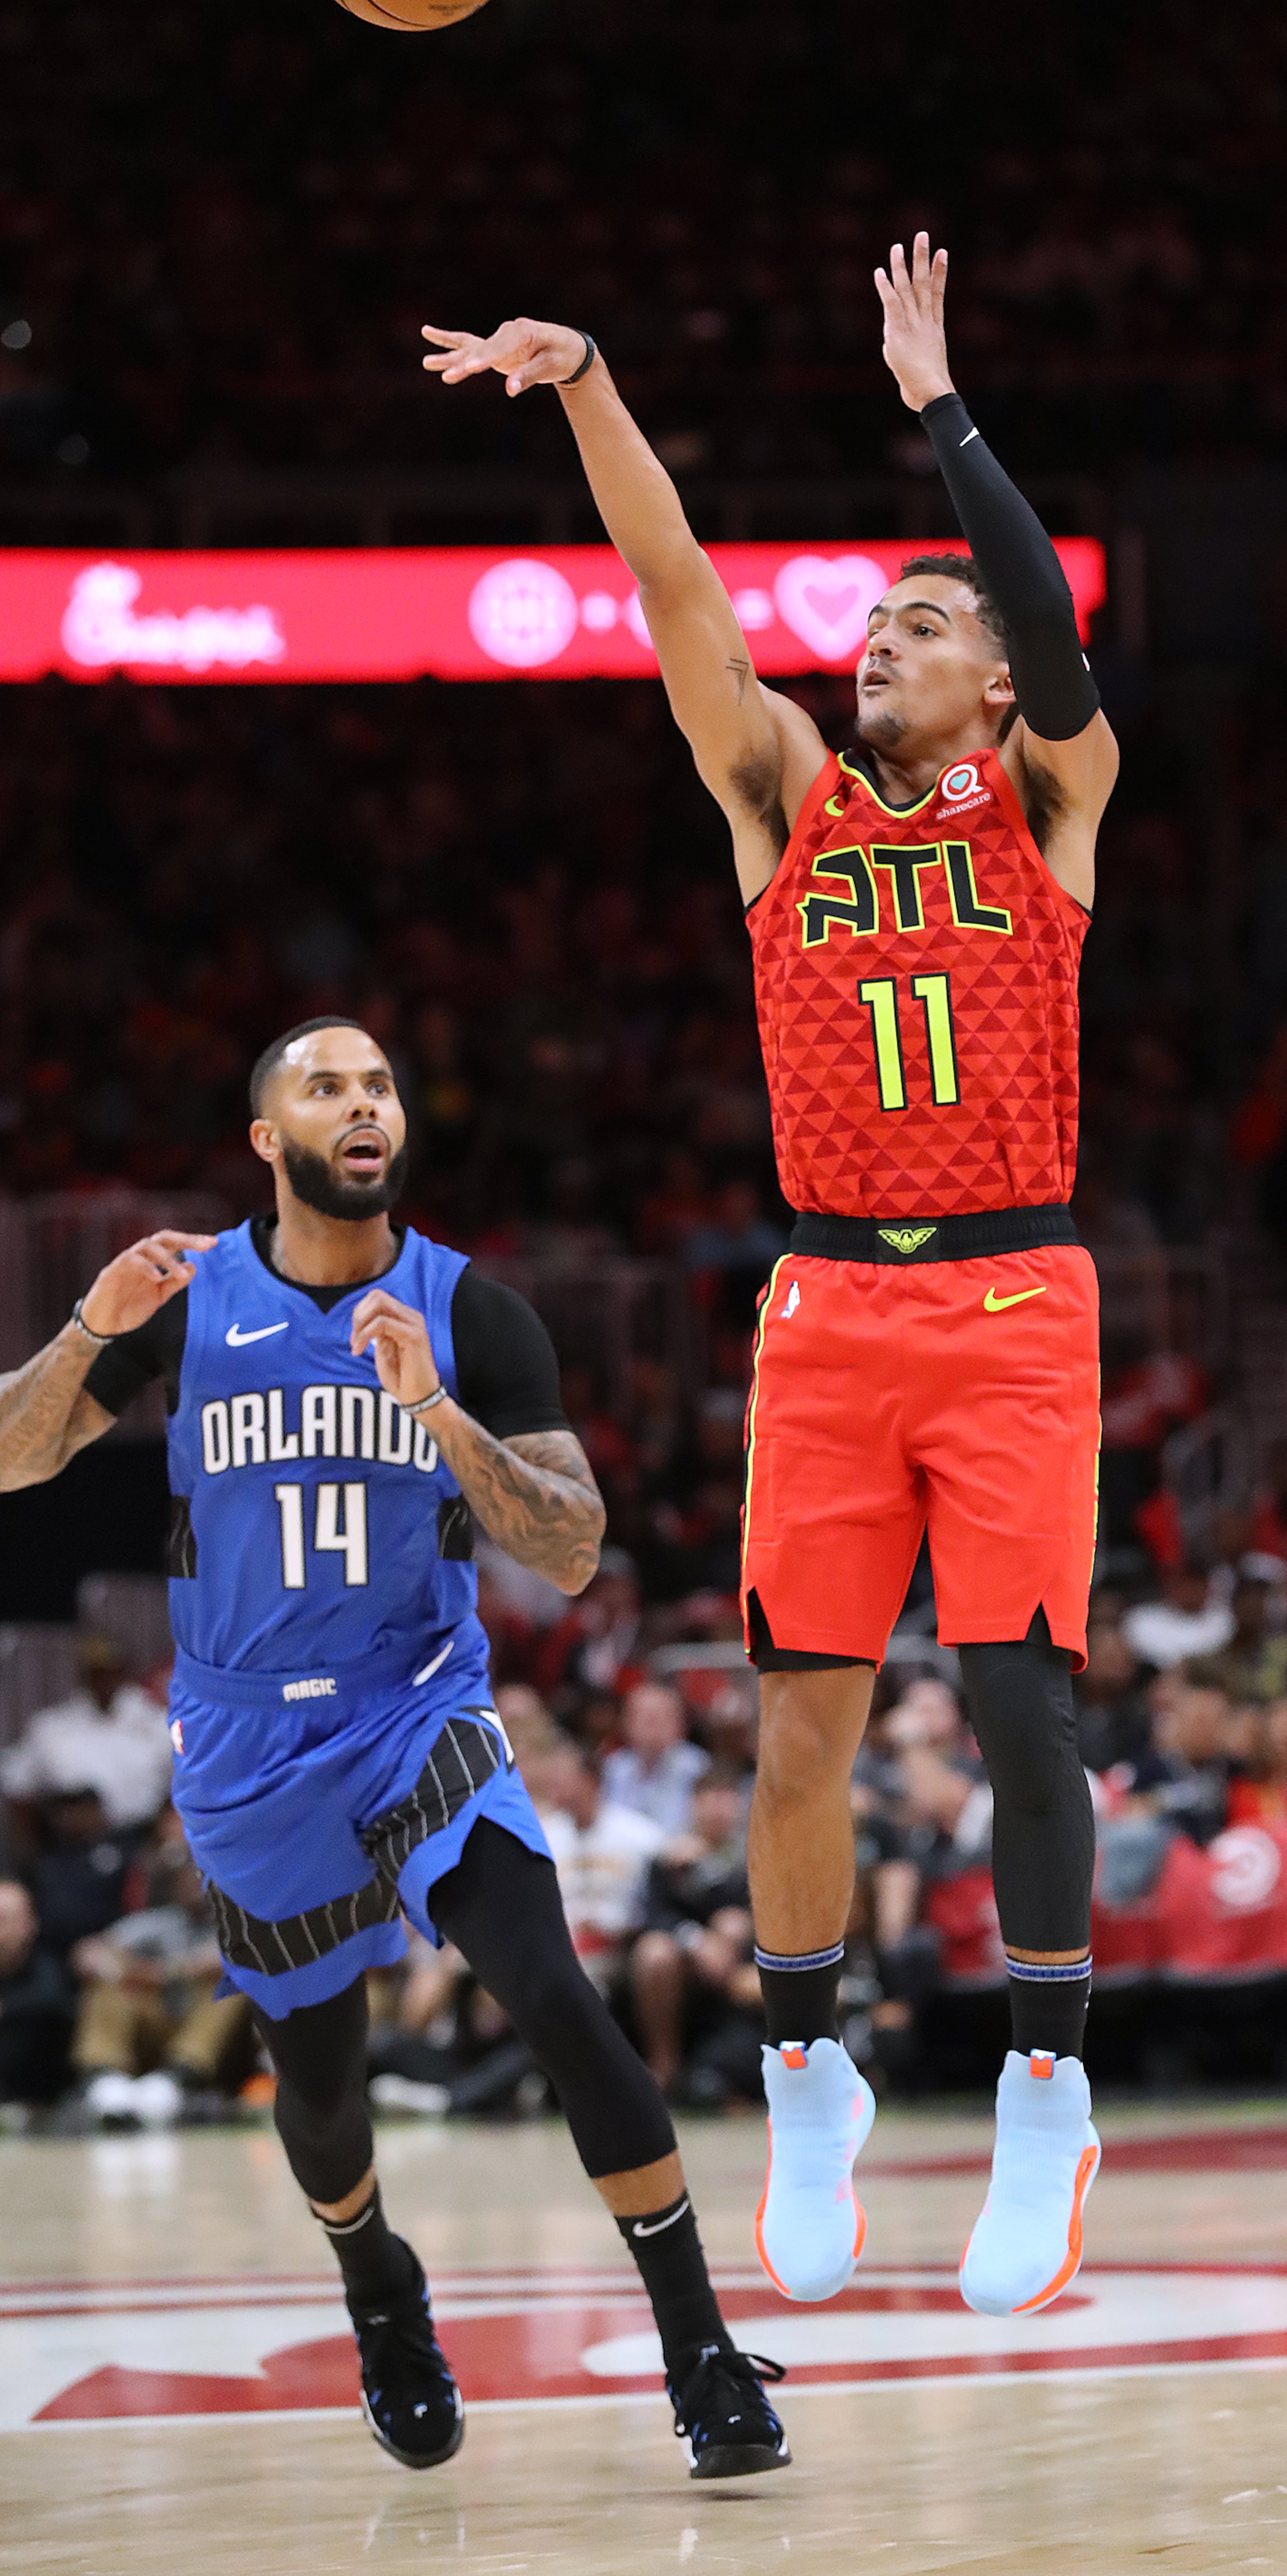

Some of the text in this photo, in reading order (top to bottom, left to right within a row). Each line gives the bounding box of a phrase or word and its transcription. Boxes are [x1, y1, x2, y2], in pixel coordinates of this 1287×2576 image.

[936, 793, 990, 820] sharecare
[796, 840, 1014, 949] ATL
[857, 971, 961, 1112] 11
[274, 1482, 369, 1590] 14
[283, 1677, 337, 1702] MAGIC
